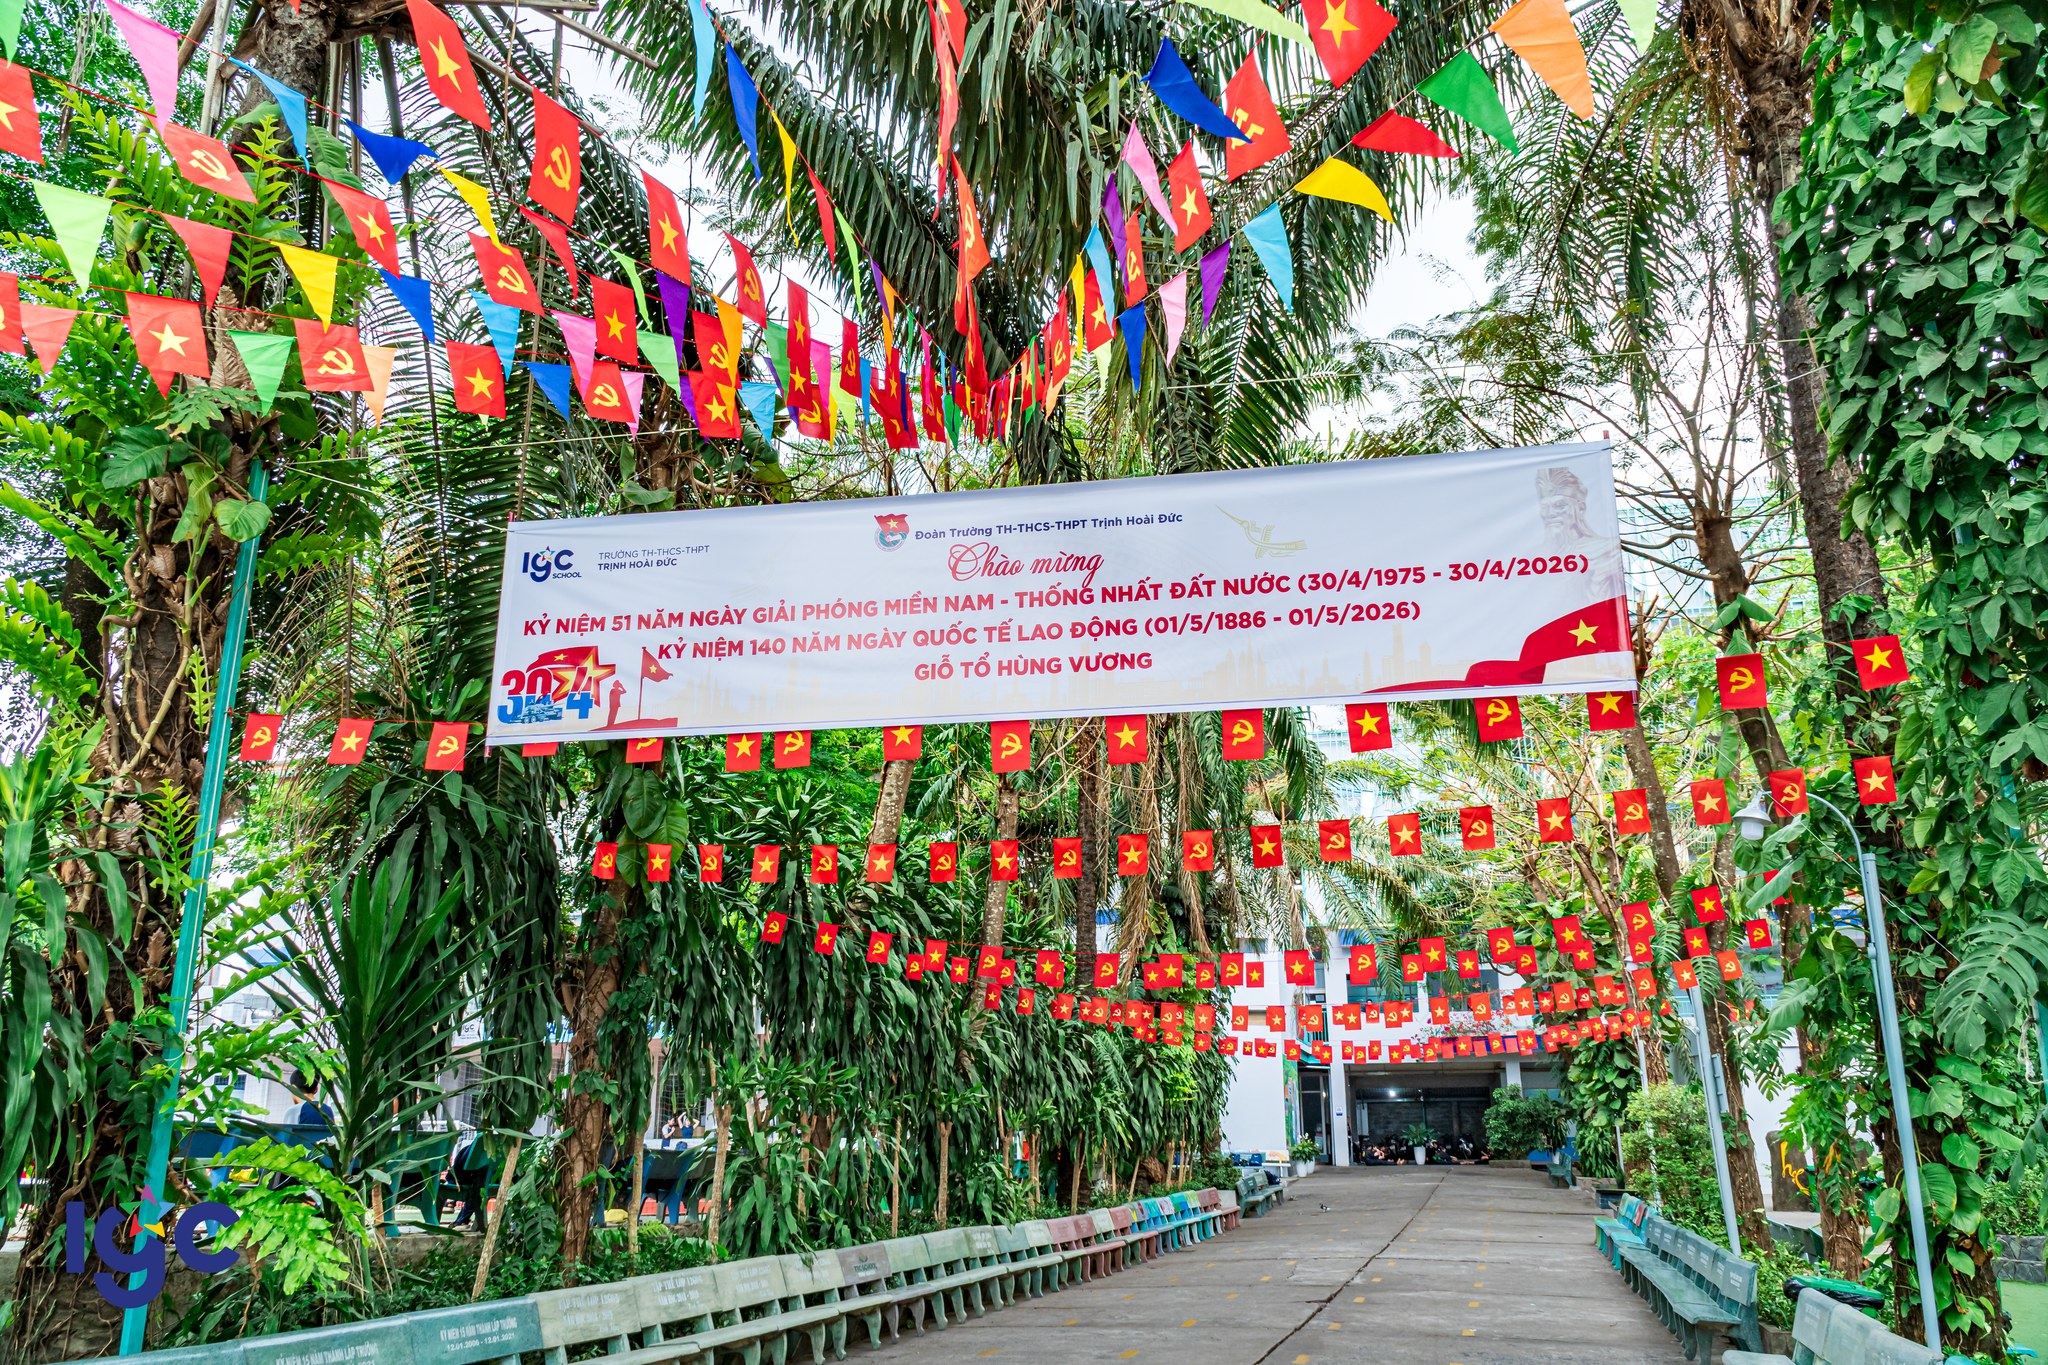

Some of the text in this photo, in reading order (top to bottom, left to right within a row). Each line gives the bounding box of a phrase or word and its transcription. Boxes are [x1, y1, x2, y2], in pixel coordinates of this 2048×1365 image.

[915, 512, 1183, 540] Đoàn Trường TH-THCS-THPT Trịnh Hoài Đức
[598, 556, 678, 572] TRỊNH HOÀI ĐỨC
[599, 545, 710, 561] TRƯỜNG TH-THCS-THPT
[948, 542, 1025, 581] Chào
[1030, 550, 1104, 588] mừng
[552, 571, 582, 580] SCHOOL
[524, 613, 551, 636] KỶ
[556, 613, 606, 636] NIỆM
[611, 615, 632, 632] 51
[637, 609, 684, 631] NĂM
[689, 605, 748, 627] NGÀY
[752, 599, 796, 624] GIẢI
[802, 598, 878, 621] PHÓNG
[884, 591, 938, 616] MIỀN
[944, 594, 994, 613] NAM
[1014, 582, 1095, 609] THỐNG
[1101, 577, 1163, 604] NHẤT
[1169, 573, 1217, 599] ĐẤT
[1223, 572, 1291, 597] NƯỚC
[1297, 567, 1426, 594] (30/4/1975
[1449, 554, 1589, 582] 30/4/2026)
[658, 637, 687, 660] KỶ
[692, 636, 744, 661] NIỆM
[750, 637, 786, 656] 140
[792, 631, 841, 653] NĂM
[847, 627, 907, 650] NGÀY
[913, 620, 977, 646] QUỐC
[983, 618, 1014, 643] TẾ
[1017, 623, 1064, 642] LAO
[1070, 616, 1138, 642] ĐỘNG
[1145, 611, 1267, 637] (01/5/1886
[1288, 601, 1421, 627] 01/5/2026)
[914, 652, 1152, 680] GIỖ TỔ HÙNG VƯƠNG
